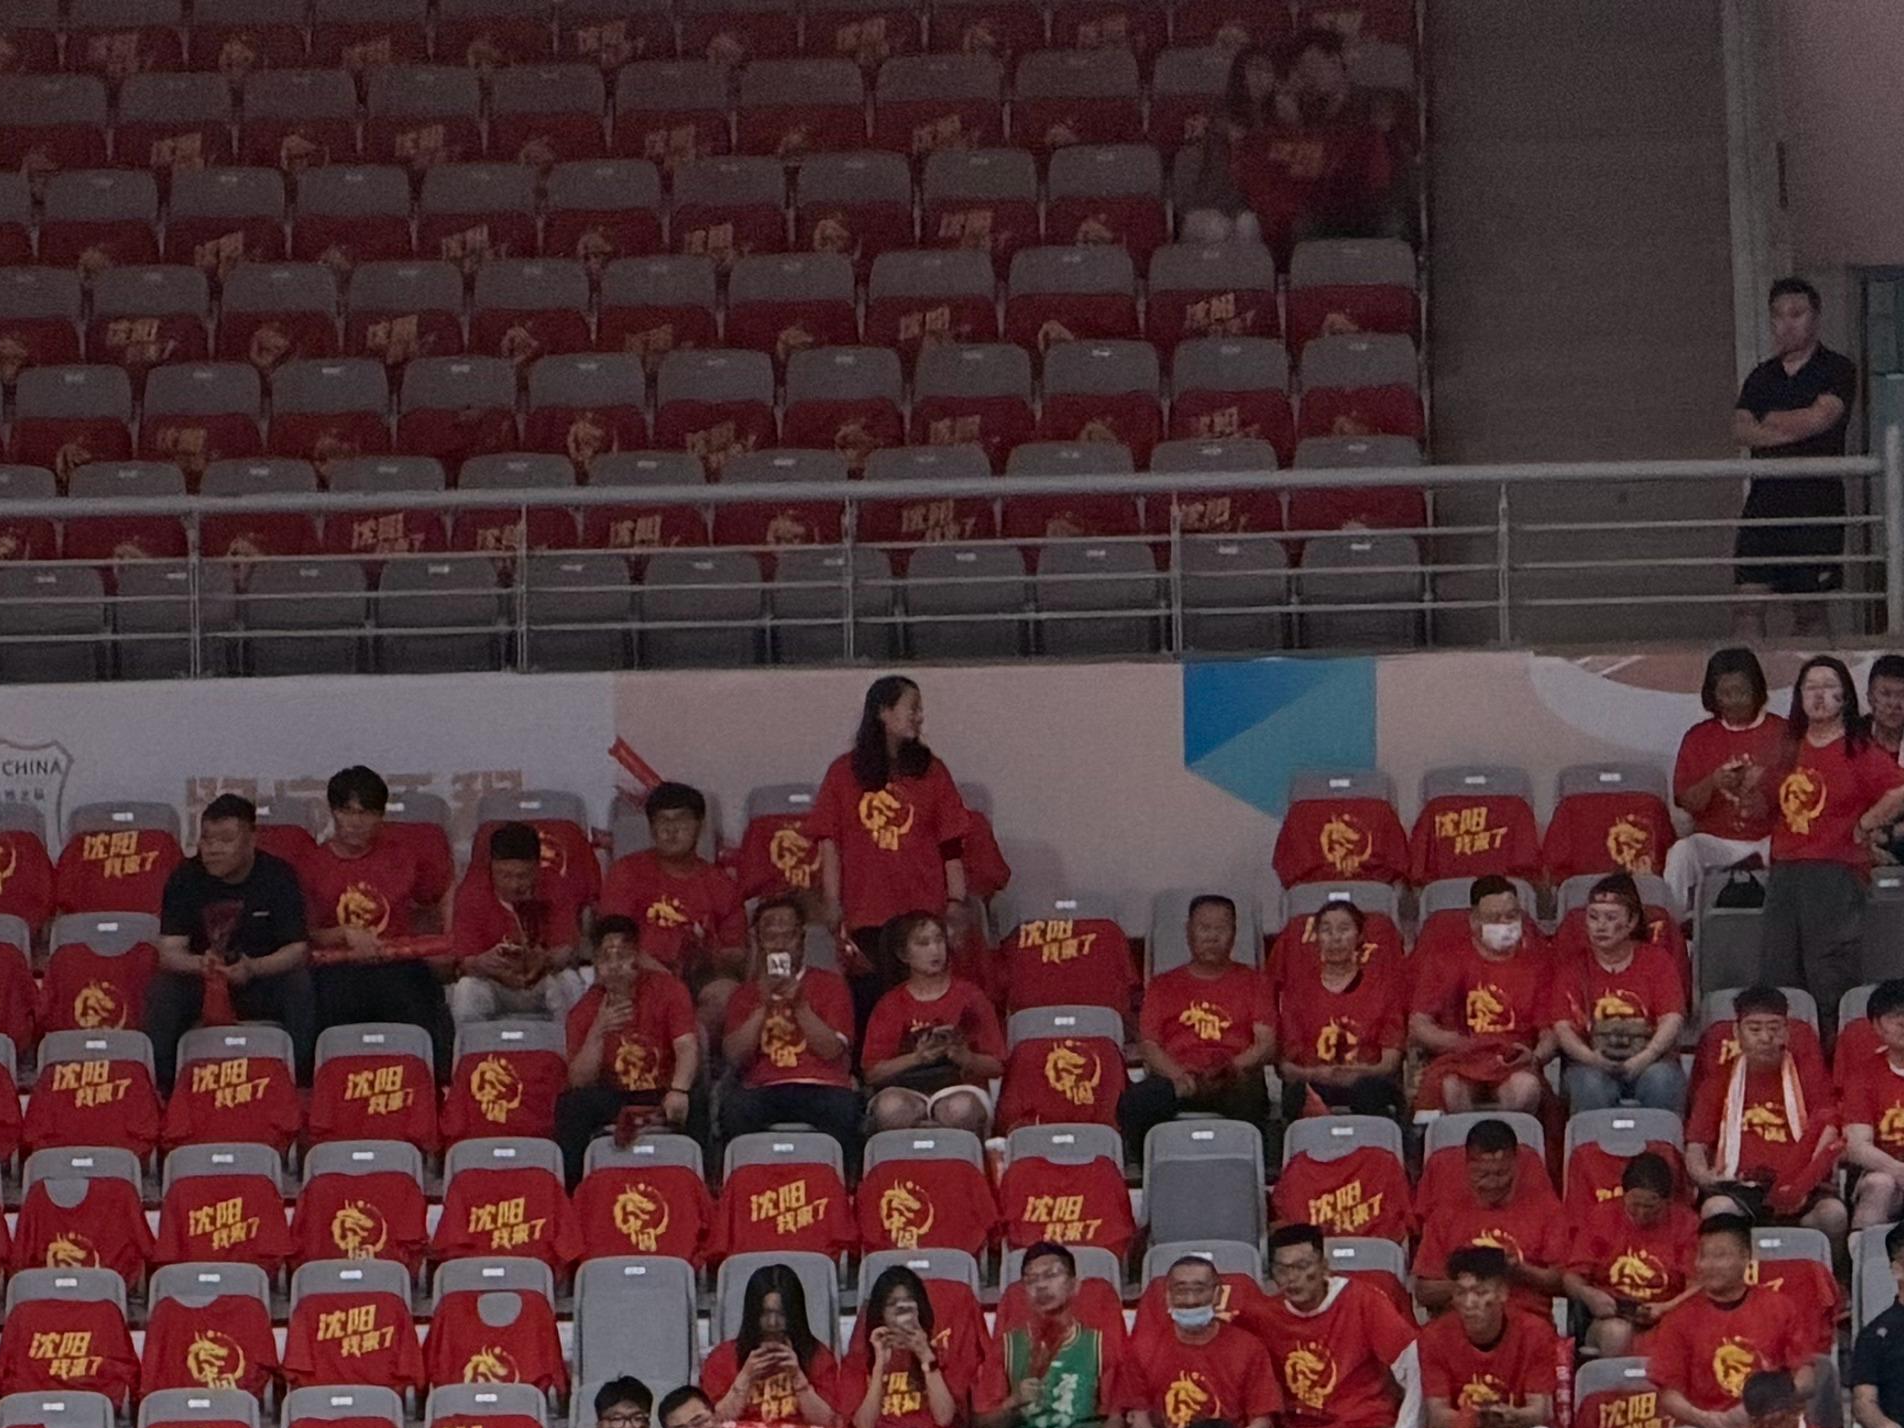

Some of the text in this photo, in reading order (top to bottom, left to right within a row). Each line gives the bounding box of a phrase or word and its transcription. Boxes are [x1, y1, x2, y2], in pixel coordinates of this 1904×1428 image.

[2, 757, 63, 777] CHINA
[1435, 807, 1487, 837] 沈阳
[83, 830, 139, 860] 沈阳
[1019, 918, 1074, 948] 沈阳
[53, 1058, 111, 1091] 沈阳
[193, 1058, 248, 1092] 沈阳
[189, 1197, 242, 1236] 沈阳
[469, 1198, 525, 1232] 沈阳
[751, 1180, 805, 1221] 沈阳
[1023, 1195, 1083, 1222] 沈阳
[1309, 1181, 1363, 1224] 沈阳
[317, 1305, 376, 1340] 沈阳
[29, 1332, 91, 1359] 沈阳
